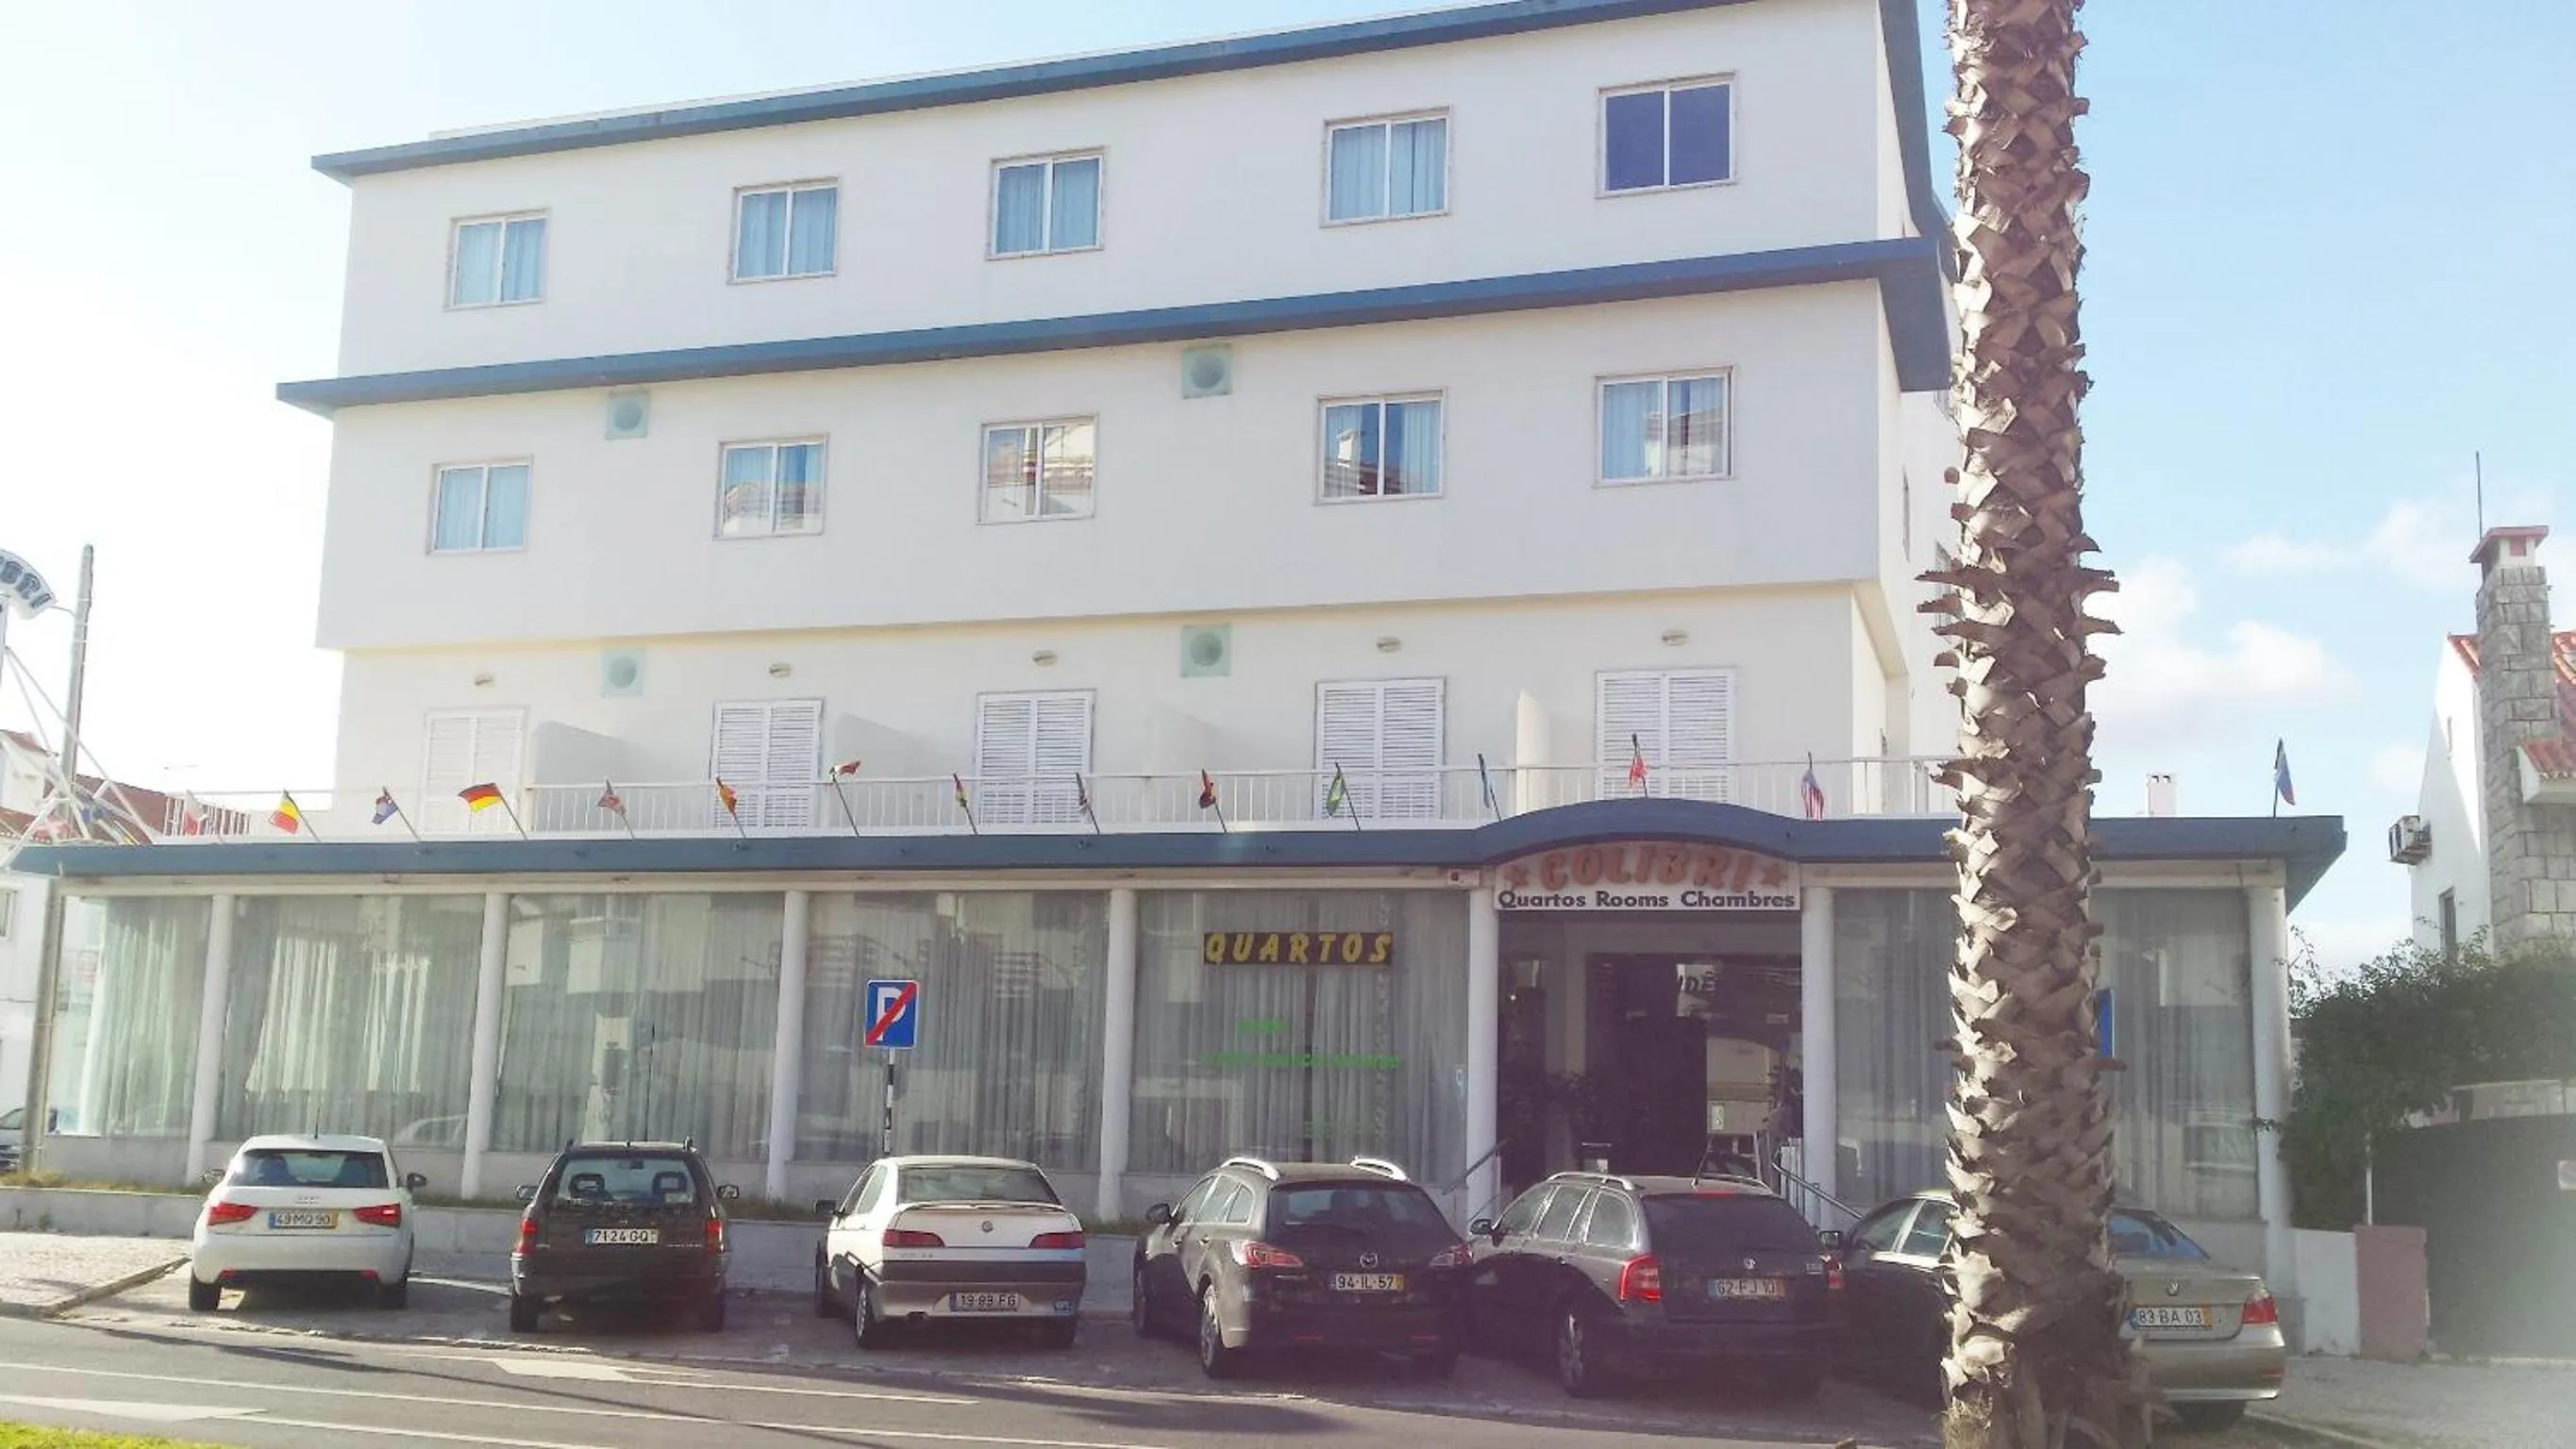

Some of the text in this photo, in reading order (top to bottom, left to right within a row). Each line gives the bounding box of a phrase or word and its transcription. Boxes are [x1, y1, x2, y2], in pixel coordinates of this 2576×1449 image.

[1539, 844, 1754, 893] COLIBRI
[1497, 890, 1796, 908] Quartos Rooms Chambres
[1205, 933, 1392, 964] QUARTOS
